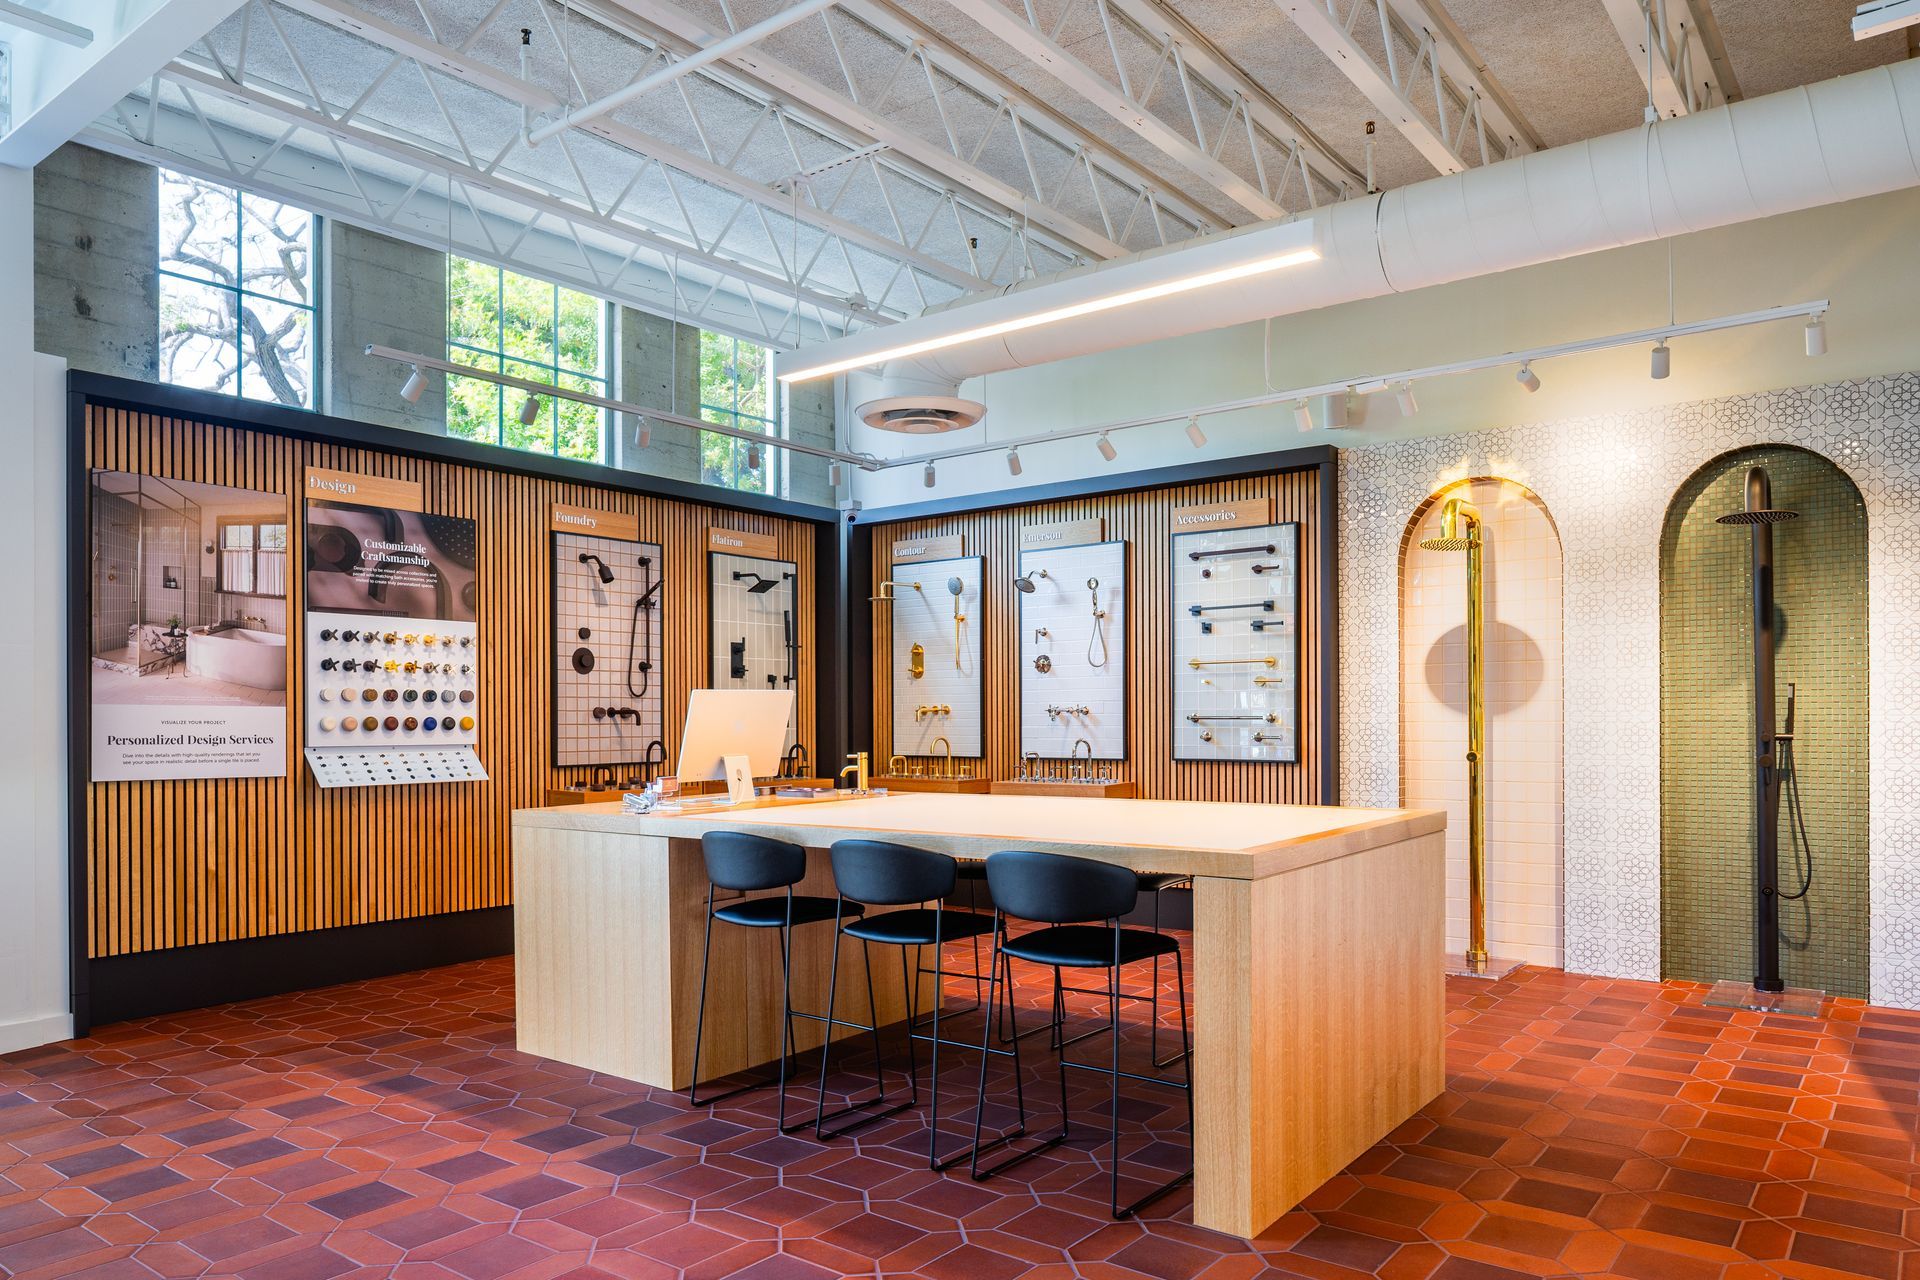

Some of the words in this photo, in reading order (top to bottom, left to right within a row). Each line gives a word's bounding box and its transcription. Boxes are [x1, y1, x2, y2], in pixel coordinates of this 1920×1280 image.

[310, 476, 356, 494] Design
[555, 511, 597, 528] Foundry
[1176, 510, 1236, 525] Accessories
[712, 534, 743, 547] Flatiron
[1023, 532, 1062, 542] Emerson
[364, 539, 427, 553] Customizable
[894, 546, 926, 556] Contour
[361, 550, 430, 567] Craftsmanship
[107, 735, 184, 745] Personalized
[188, 734, 226, 746] Design
[229, 734, 274, 745] Services
